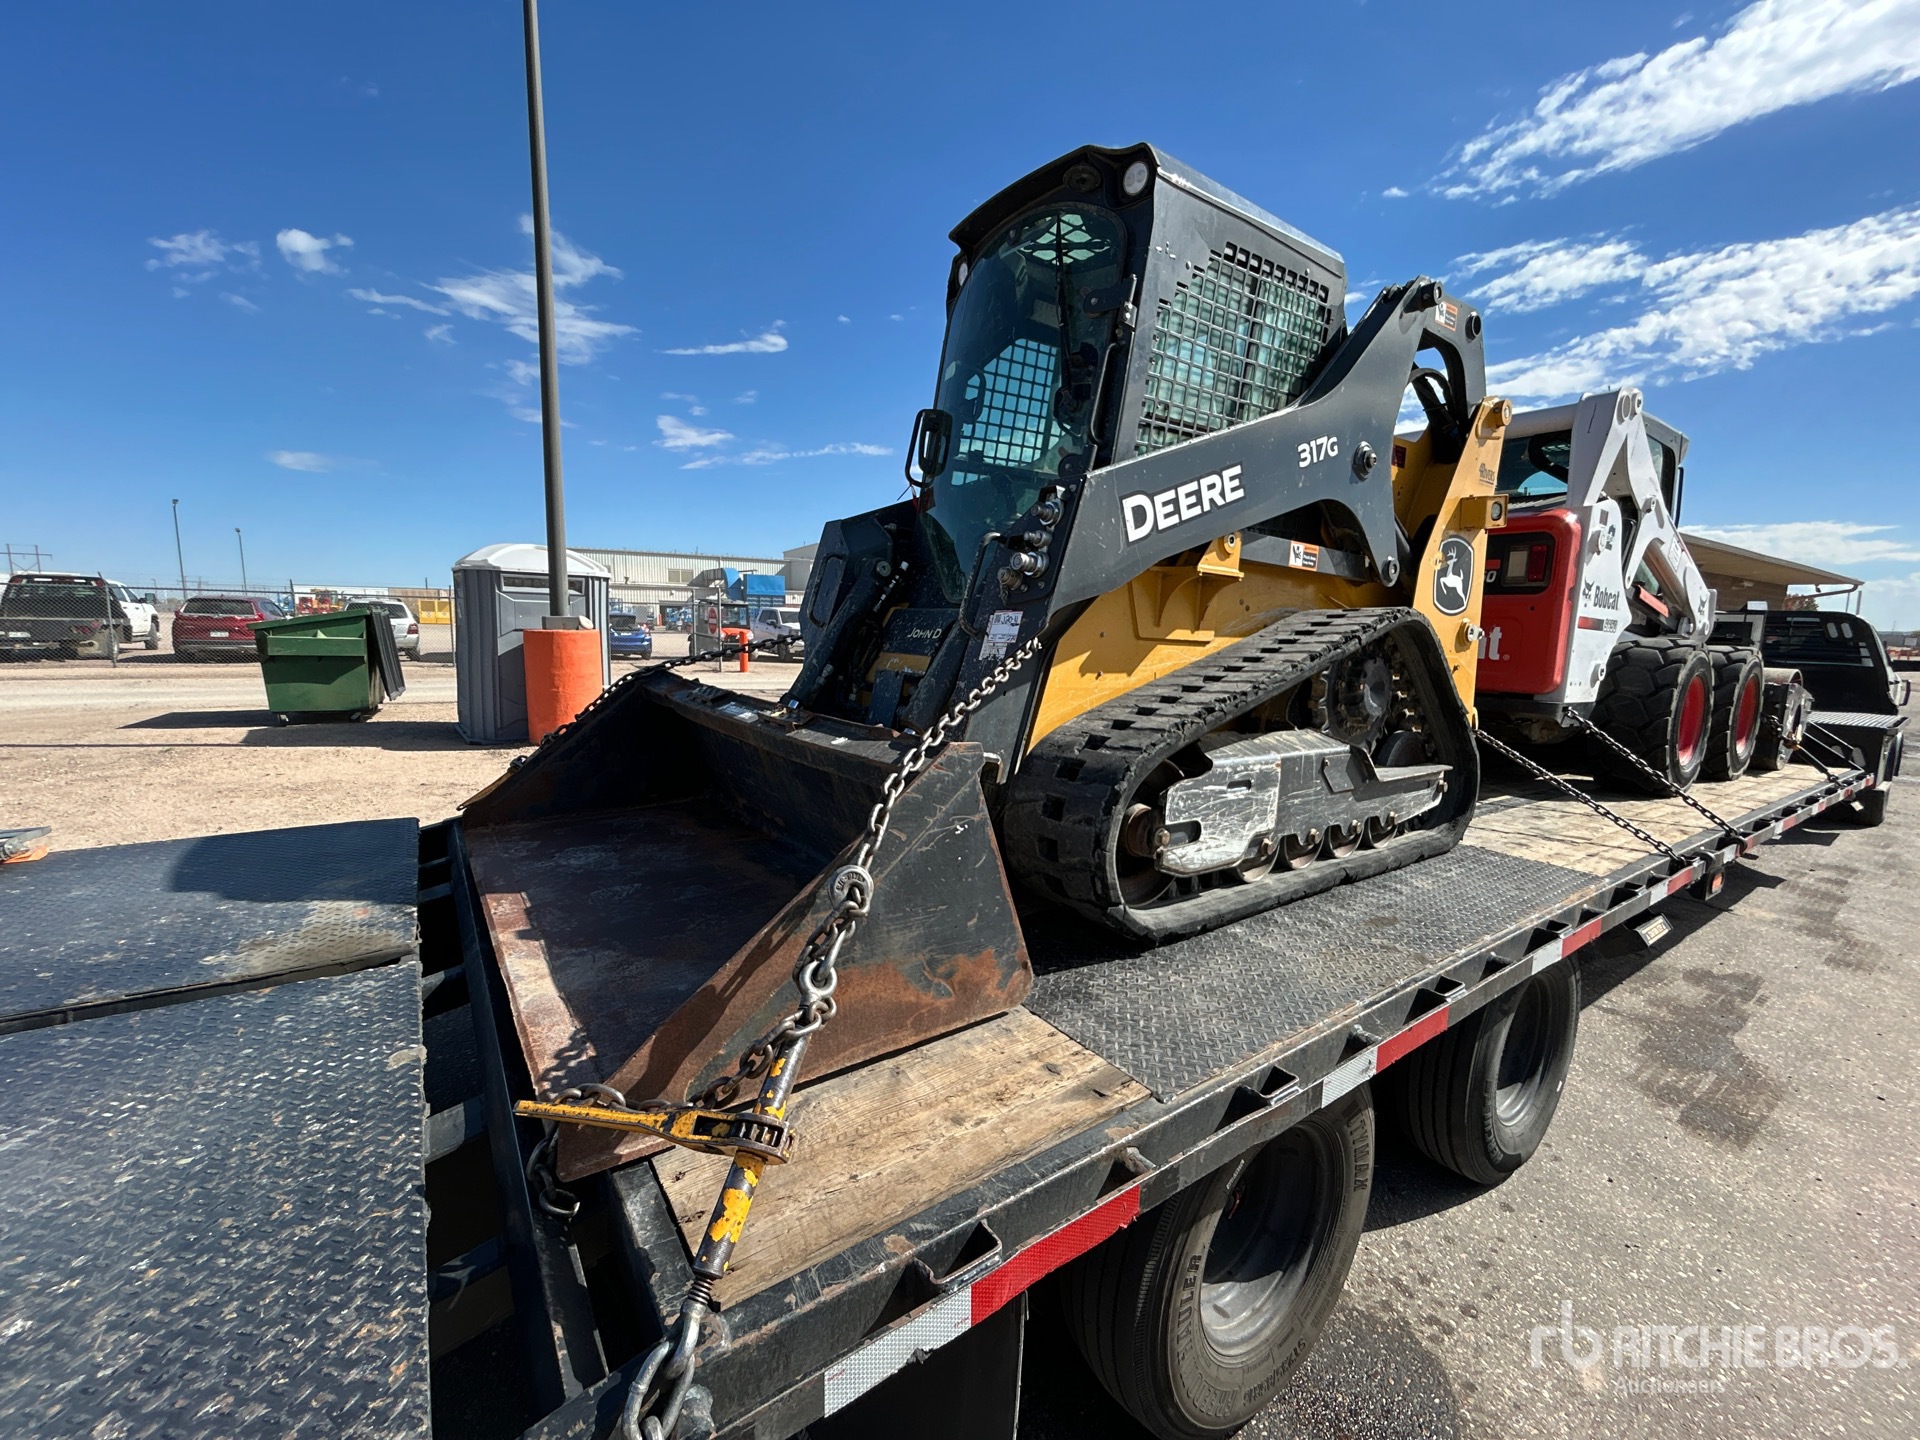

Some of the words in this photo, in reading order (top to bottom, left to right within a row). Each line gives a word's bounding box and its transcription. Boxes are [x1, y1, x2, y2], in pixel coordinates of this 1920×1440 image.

[1297, 436, 1339, 469] 317G
[1122, 464, 1246, 543] DEERE
[1592, 585, 1620, 611] Bobcat
[907, 627, 933, 639] JOHN
